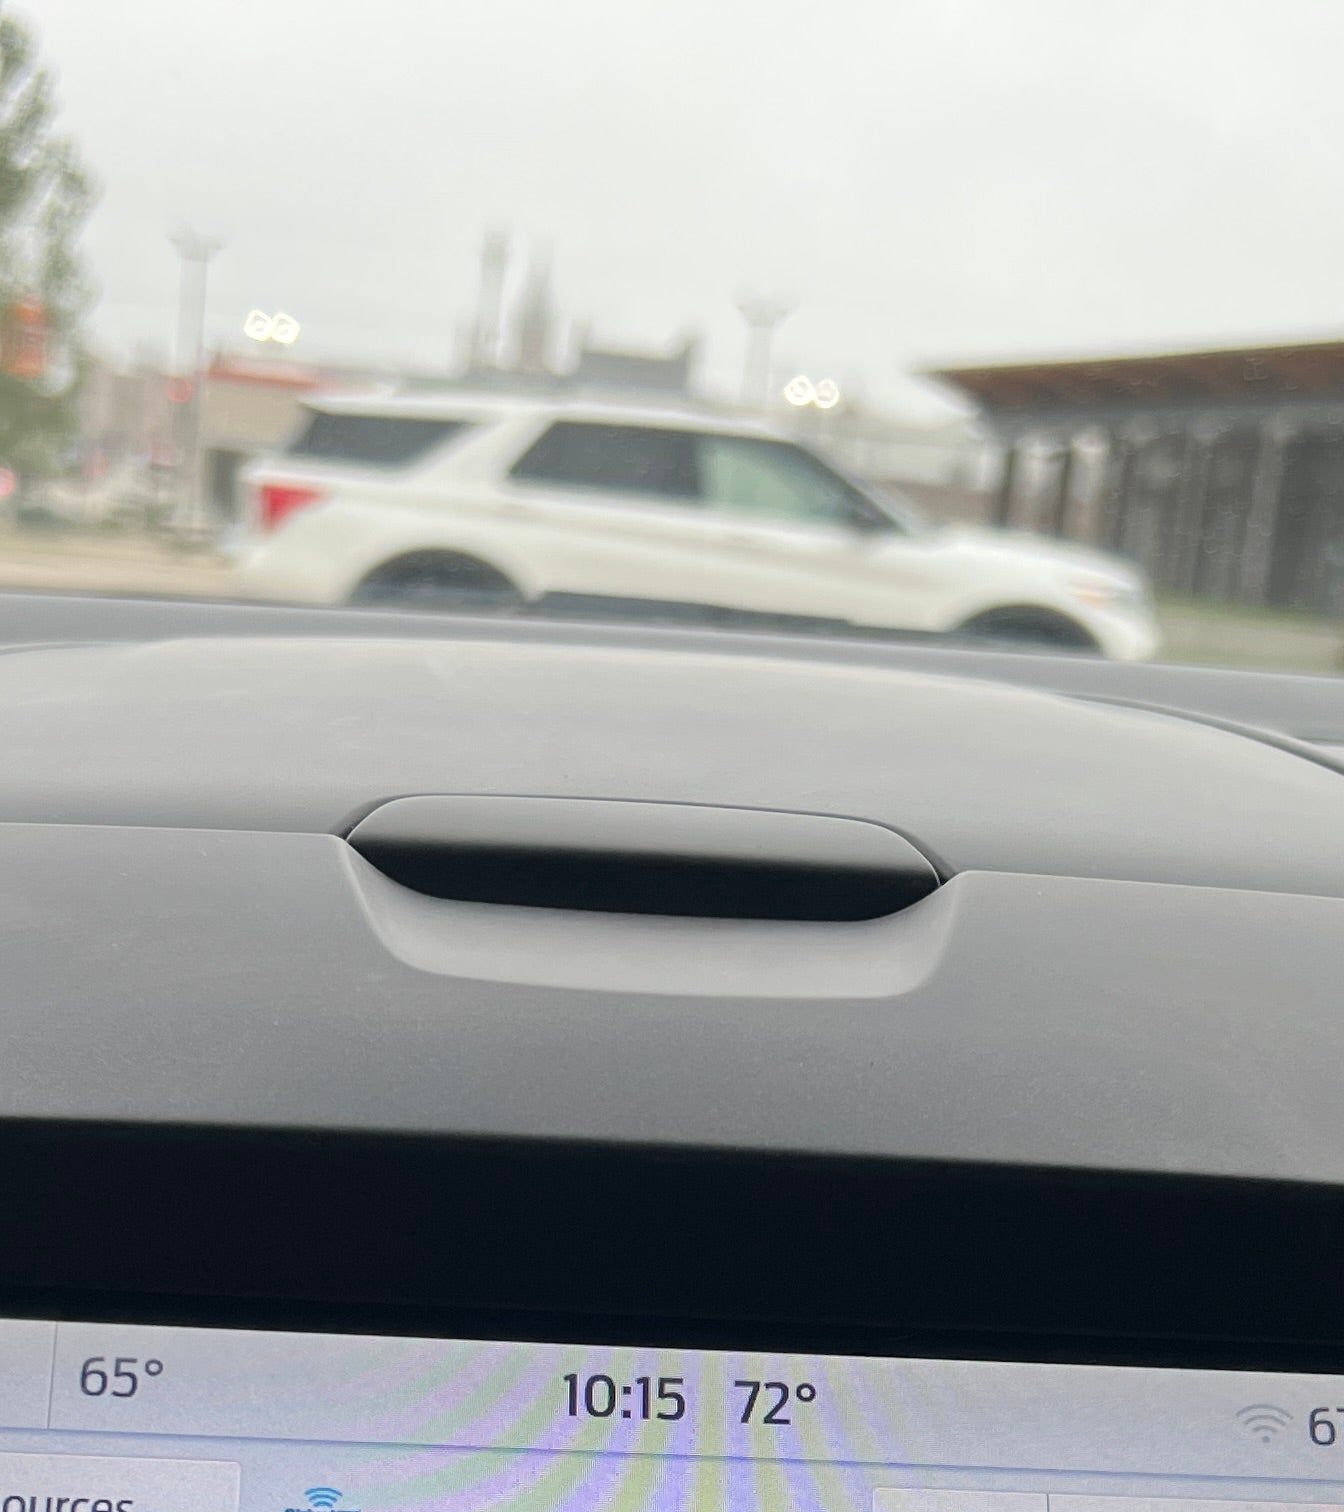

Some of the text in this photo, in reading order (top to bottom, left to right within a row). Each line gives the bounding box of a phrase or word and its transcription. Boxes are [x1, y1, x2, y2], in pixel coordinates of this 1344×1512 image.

[79, 1356, 165, 1399] 65°
[562, 1372, 687, 1422] 10:15
[733, 1379, 818, 1426] 72°
